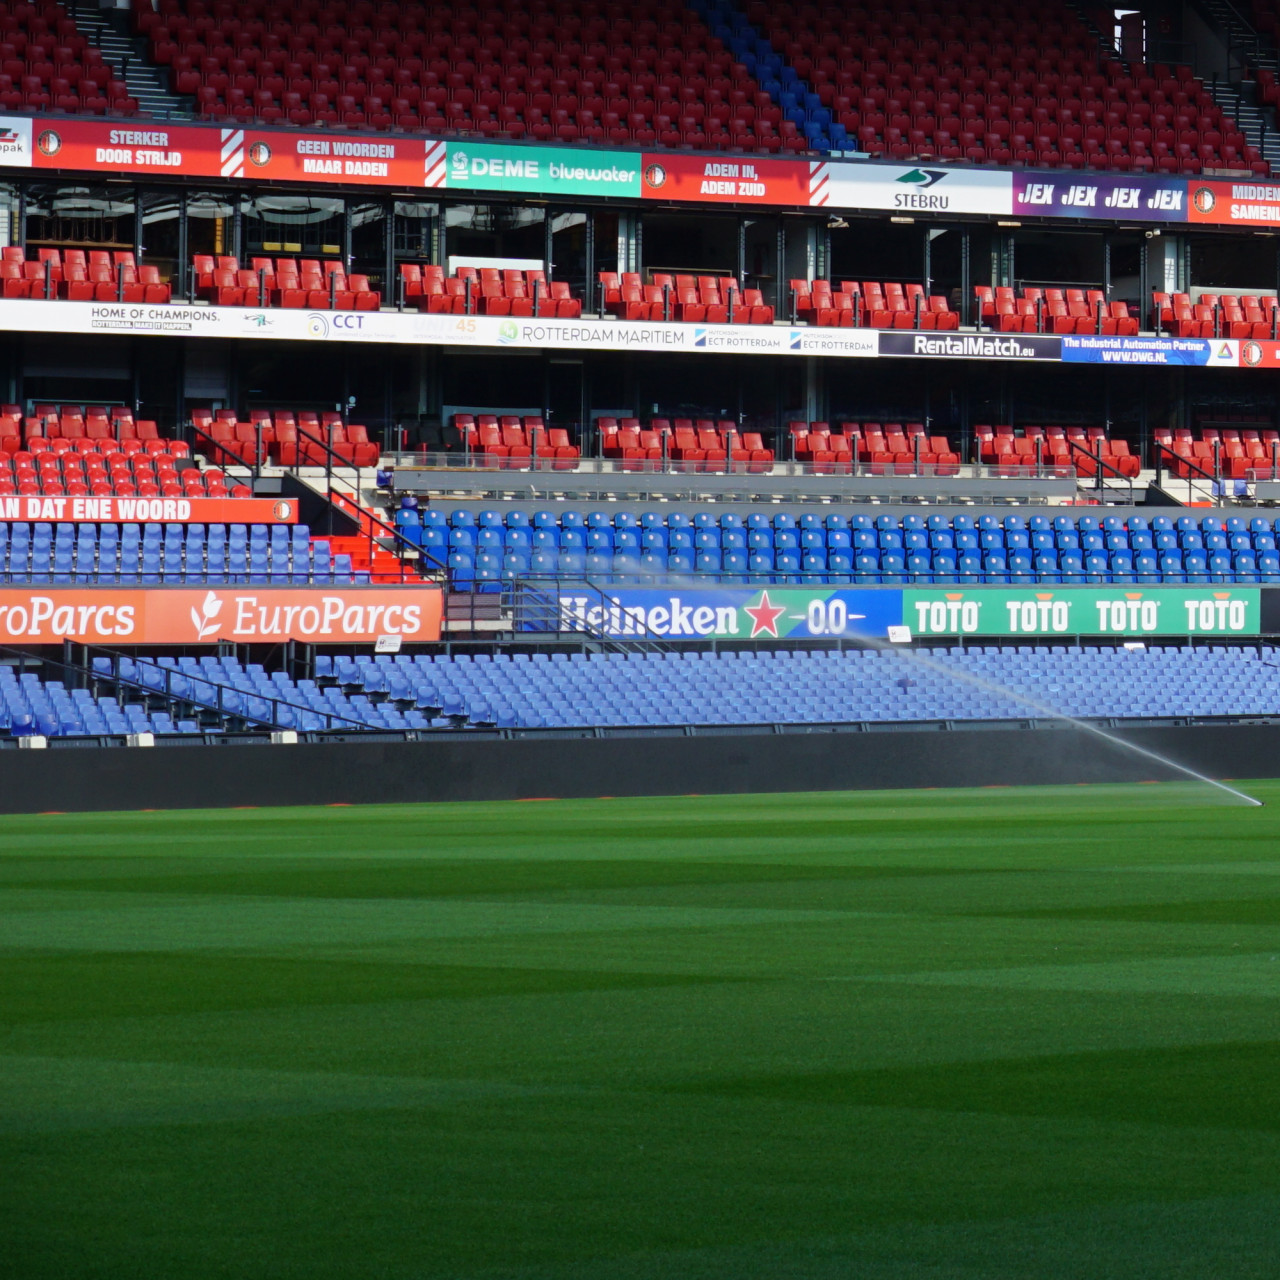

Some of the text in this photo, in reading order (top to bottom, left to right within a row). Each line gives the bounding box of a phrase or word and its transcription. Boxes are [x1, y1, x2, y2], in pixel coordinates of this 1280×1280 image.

[110, 130, 168, 146] STERKER
[0, 144, 23, 153] pak
[96, 148, 181, 166] DOOR STRIJD
[297, 140, 394, 159] GEEN WOORDEN
[303, 159, 388, 177] MAAR DADEN
[471, 158, 539, 178] DEME
[549, 161, 636, 183] bluewater
[704, 163, 759, 181] ADEM IN,
[700, 180, 765, 197] ADEM ZUID
[1018, 183, 1183, 211] JEX JEX JEX JEX
[1232, 185, 1280, 202] MIDDEN
[895, 193, 949, 210] STEBRU
[91, 307, 221, 323] HOME OF CHAMPIONS.
[333, 314, 365, 329] CCT
[134, 321, 153, 329] MAKE
[155, 322, 162, 330] IT
[523, 326, 684, 346] ROTTERDAM MARITIEM
[708, 338, 780, 348] ECT ROTTERDAM
[1063, 338, 1205, 352] The Industrial Automation Partner
[803, 340, 873, 351] ECT ROTTERDAM
[914, 335, 1035, 358] RentalMatch.eu
[1102, 351, 1168, 363] WWW.DWG.NL
[28, 499, 66, 518] DAT
[73, 499, 111, 519] ENE
[118, 500, 191, 520] WOORD
[233, 596, 421, 635] EuroParcs
[559, 596, 739, 635] Heineken
[807, 598, 847, 635] 0.0
[915, 599, 1245, 633] TOTO TOTO TOTO TOTO
